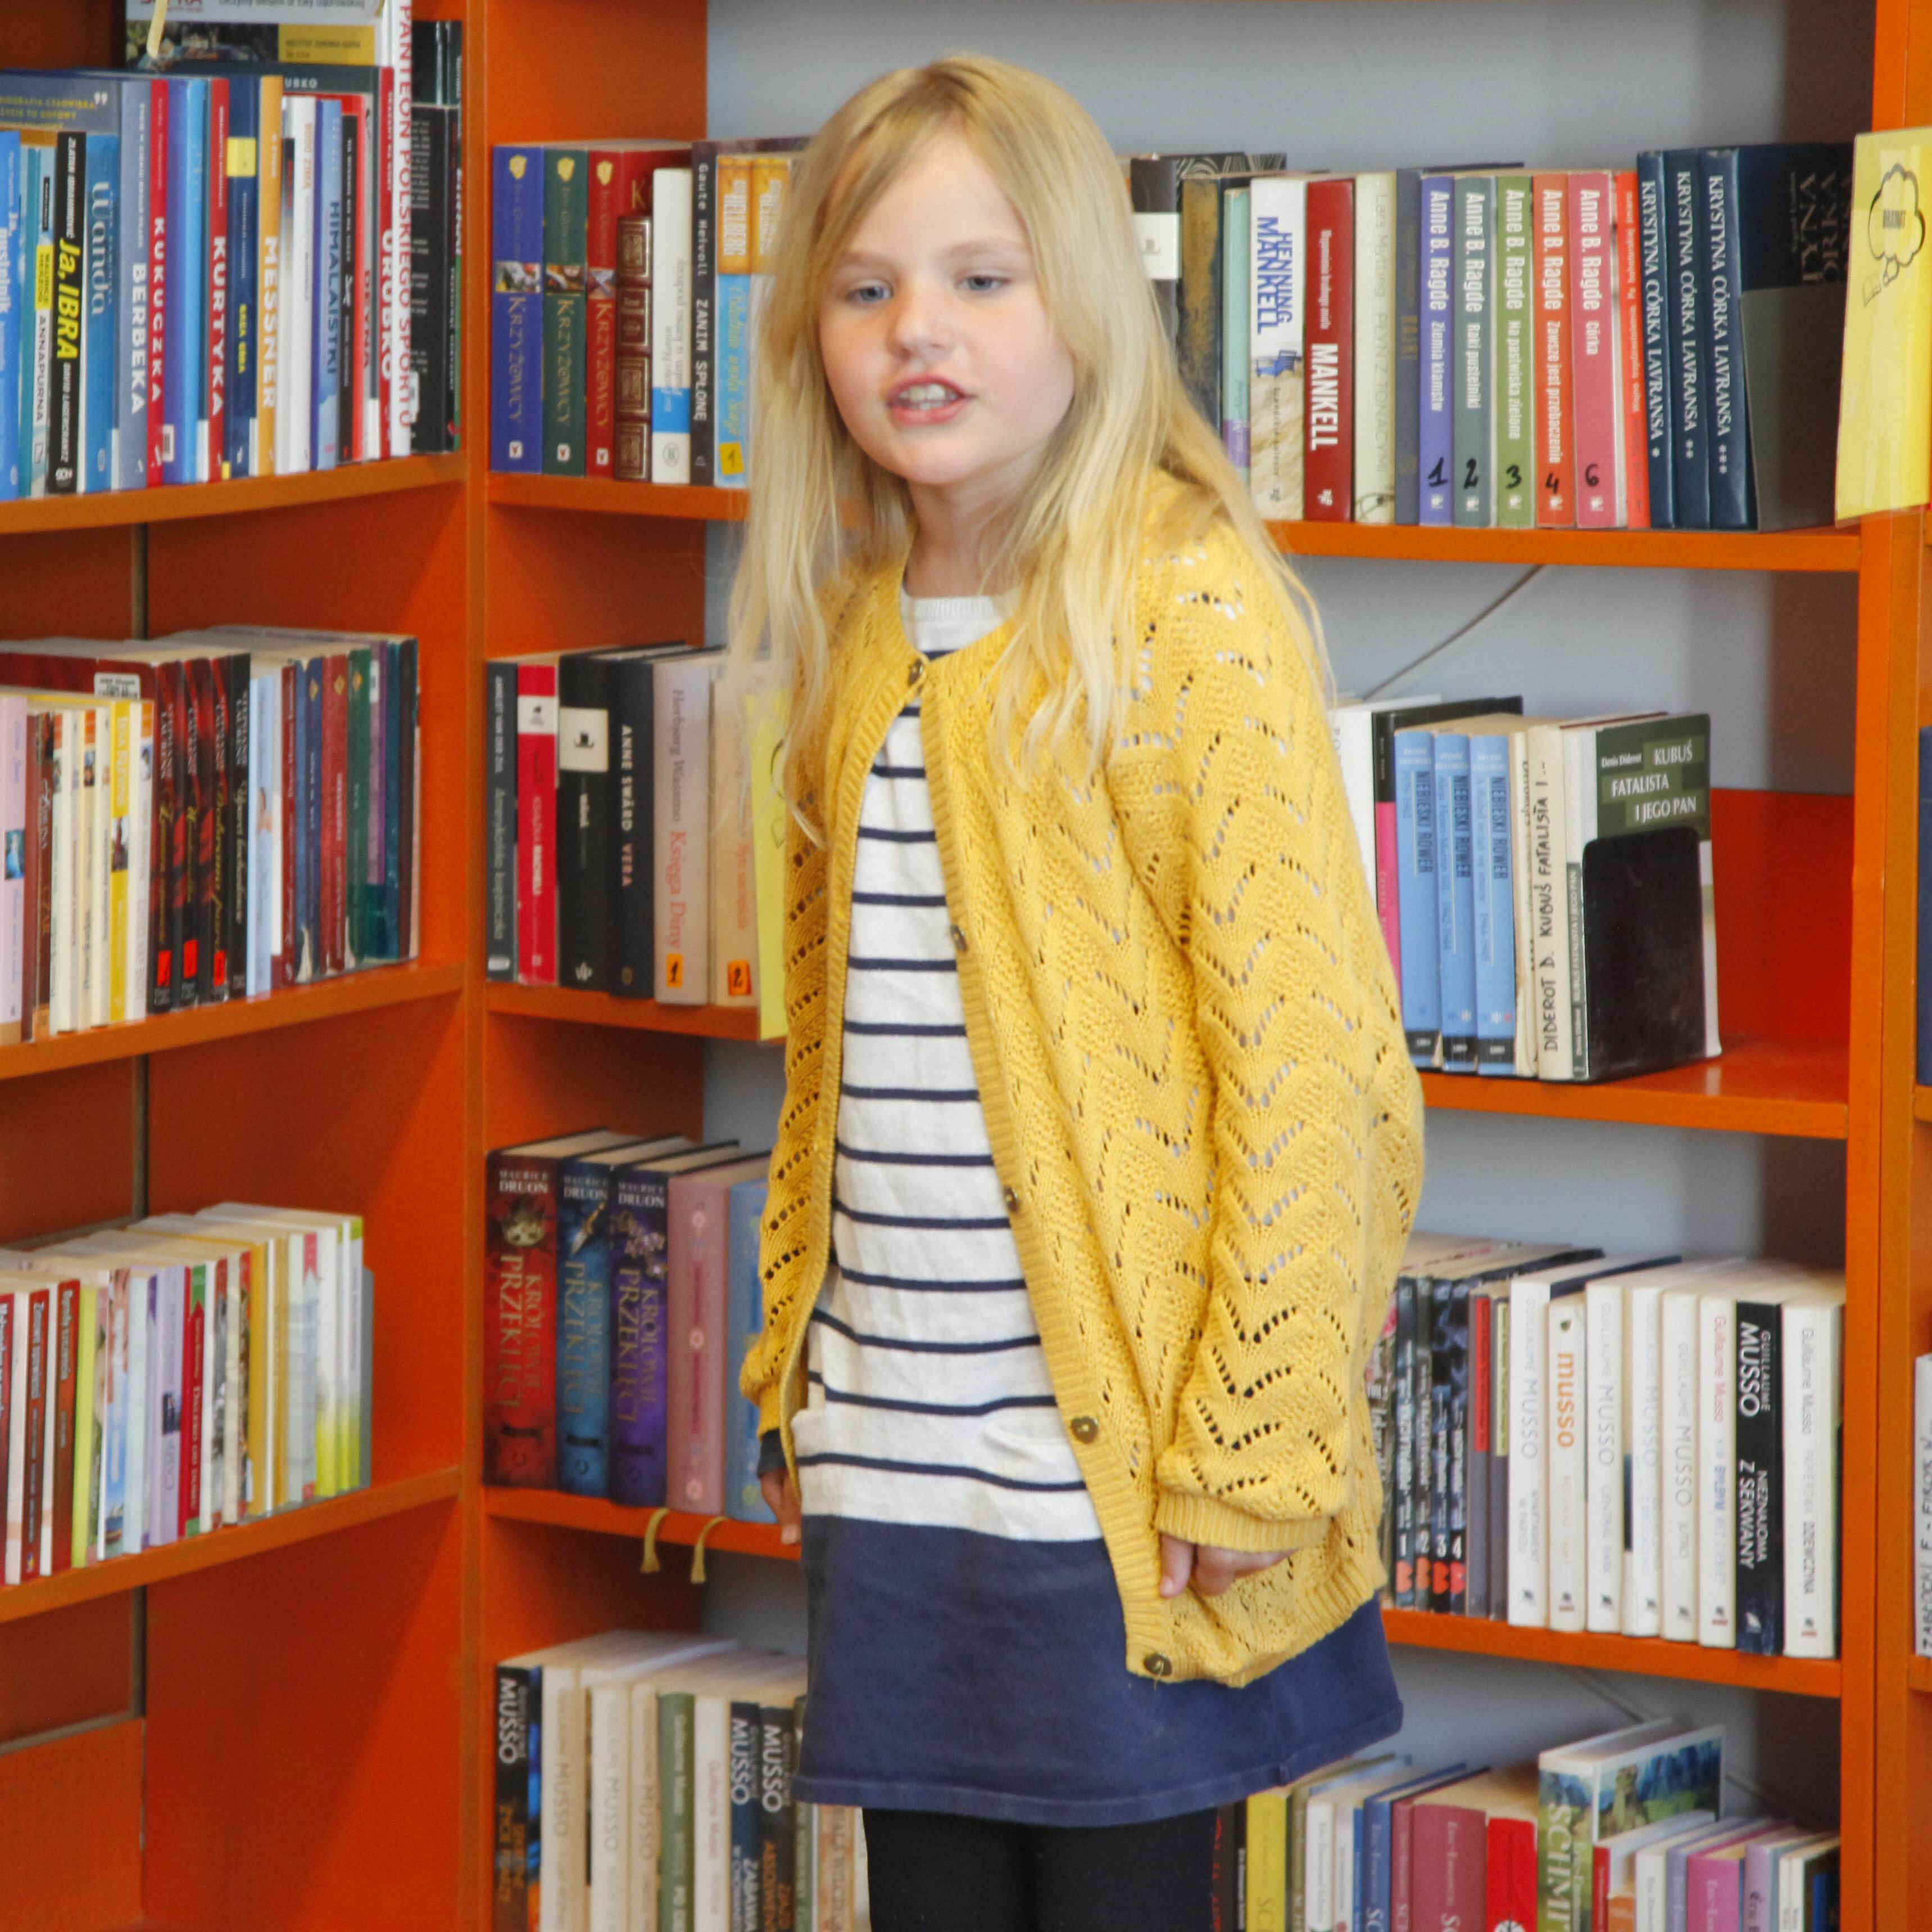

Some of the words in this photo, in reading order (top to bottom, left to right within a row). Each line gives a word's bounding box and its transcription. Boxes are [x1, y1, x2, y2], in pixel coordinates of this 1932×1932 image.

[399, 4, 412, 140] PANTEON
[697, 162, 708, 211] Gaute
[1375, 195, 1390, 229] Lars
[1429, 191, 1450, 234] Anne
[1466, 192, 1486, 236] Anne
[1505, 189, 1525, 233] Anne
[1543, 189, 1563, 233] Anne
[1580, 189, 1600, 233] Anne
[399, 149, 412, 309] POLSKIEGO
[723, 194, 747, 256] HELLBERG
[1430, 238, 1449, 253] B.
[1506, 237, 1525, 252] B.
[1543, 237, 1563, 252] B.
[1581, 237, 1600, 252] B.
[1641, 180, 1661, 276] KRYSTYNA
[1677, 171, 1694, 266] KRYSTYNA
[1708, 175, 1726, 271] KRYSTYNA
[58, 238, 81, 280] Ja,
[91, 182, 111, 316] Wanda
[696, 219, 707, 278] Heivoll
[1257, 216, 1280, 335] MANKELL
[1466, 241, 1485, 255] B.
[326, 202, 341, 375] HIMALAISTKI
[380, 229, 393, 380] URUBKO
[1273, 232, 1294, 323] HENNING
[1427, 258, 1450, 310] Ragde
[1463, 259, 1485, 312] Ragde
[1504, 256, 1525, 310] Ragde
[1541, 256, 1563, 310] Ragde
[1580, 256, 1602, 310] Ragde
[1680, 270, 1698, 335] CÓRKA
[57, 284, 80, 359] IBRA
[151, 217, 165, 402] KUKUCZKA
[212, 236, 226, 416] KURTYKA
[262, 236, 279, 408] MESSNER
[695, 299, 709, 351] ZANIM
[1508, 320, 1521, 336] Na
[1645, 279, 1664, 345] CÓRKA
[1712, 275, 1731, 340] CÓRKA
[131, 262, 148, 415] BERBEKA
[1431, 321, 1445, 360] Ziemia
[1467, 323, 1481, 349] Raki
[1546, 321, 1561, 362] Zawsze
[1585, 321, 1602, 355] Córka
[36, 315, 47, 422] ANNAPURNA
[398, 318, 412, 429] SPORTU
[692, 360, 709, 422] SPŁONĘ
[1463, 351, 1481, 409] pustelniki
[1546, 365, 1562, 385] jest
[1647, 348, 1665, 441] LAVRANSA
[1681, 339, 1698, 432] LAVRANSA
[1714, 344, 1732, 437] LAVRANSA
[1311, 343, 1339, 451] MANKELL
[1508, 398, 1522, 439] zielone
[1427, 457, 1449, 488] 1
[1463, 459, 1480, 489] 2
[1505, 464, 1522, 490] 3
[1585, 464, 1600, 488] 6
[622, 724, 633, 770] ANNE
[670, 688, 686, 756] Herbjørg
[1601, 756, 1619, 768] Denis
[1619, 752, 1642, 766] Diderot
[1653, 738, 1693, 766] KUBUŚ
[1416, 771, 1432, 827] NIEBIESKI
[1452, 774, 1468, 832] NIEBIESKI
[1491, 775, 1507, 833] NIEBIESKI
[1611, 772, 1670, 799] FATALISTA
[1635, 804, 1640, 822] I
[1642, 799, 1671, 824] JEGO
[1672, 795, 1697, 815] PAN
[666, 831, 687, 896] Księga
[1417, 833, 1433, 874] ROWER
[1454, 837, 1471, 878] ROWER
[1492, 838, 1509, 880] ROWER
[1533, 797, 1551, 876] FATALISTA
[621, 843, 632, 887] VERA
[667, 901, 687, 952] Diny
[1533, 883, 1554, 937] KUBUŚ
[1539, 951, 1555, 969] D.
[1540, 976, 1559, 1053] DIDEROT
[499, 1181, 548, 1193] DRUON
[564, 1187, 607, 1200] DRUON
[619, 1193, 665, 1207] DRUON
[1714, 1315, 1726, 1377] Guillaume
[1738, 1321, 1760, 1417] MUSSO
[1759, 1330, 1772, 1412] GUILLAUME
[1802, 1326, 1815, 1389] Guillaume
[1521, 1379, 1539, 1459] MUSSO
[1557, 1352, 1576, 1449] musso
[1598, 1385, 1615, 1467] MUSSO
[1715, 1382, 1727, 1423] Musso
[1802, 1394, 1815, 1435] Musso
[1675, 1426, 1693, 1507] MUSSO
[1739, 1459, 1755, 1473] Z
[1416, 1530, 1430, 1554] 2
[1738, 1477, 1755, 1570] SEKWANY
[1756, 1470, 1769, 1562] NIEZNAJOMA
[1399, 1534, 1408, 1556] 1
[1436, 1533, 1448, 1558] 3
[1452, 1536, 1462, 1559] 4
[1802, 1521, 1815, 1595] DZIEWCZYNA
[498, 1677, 518, 1765] MUSSO
[732, 1717, 751, 1806] MUSSO
[761, 1724, 783, 1813] MUSSO
[553, 1763, 569, 1838] MUSSO
[604, 1776, 620, 1853] MUSSO
[638, 1784, 655, 1860] MUSSO
